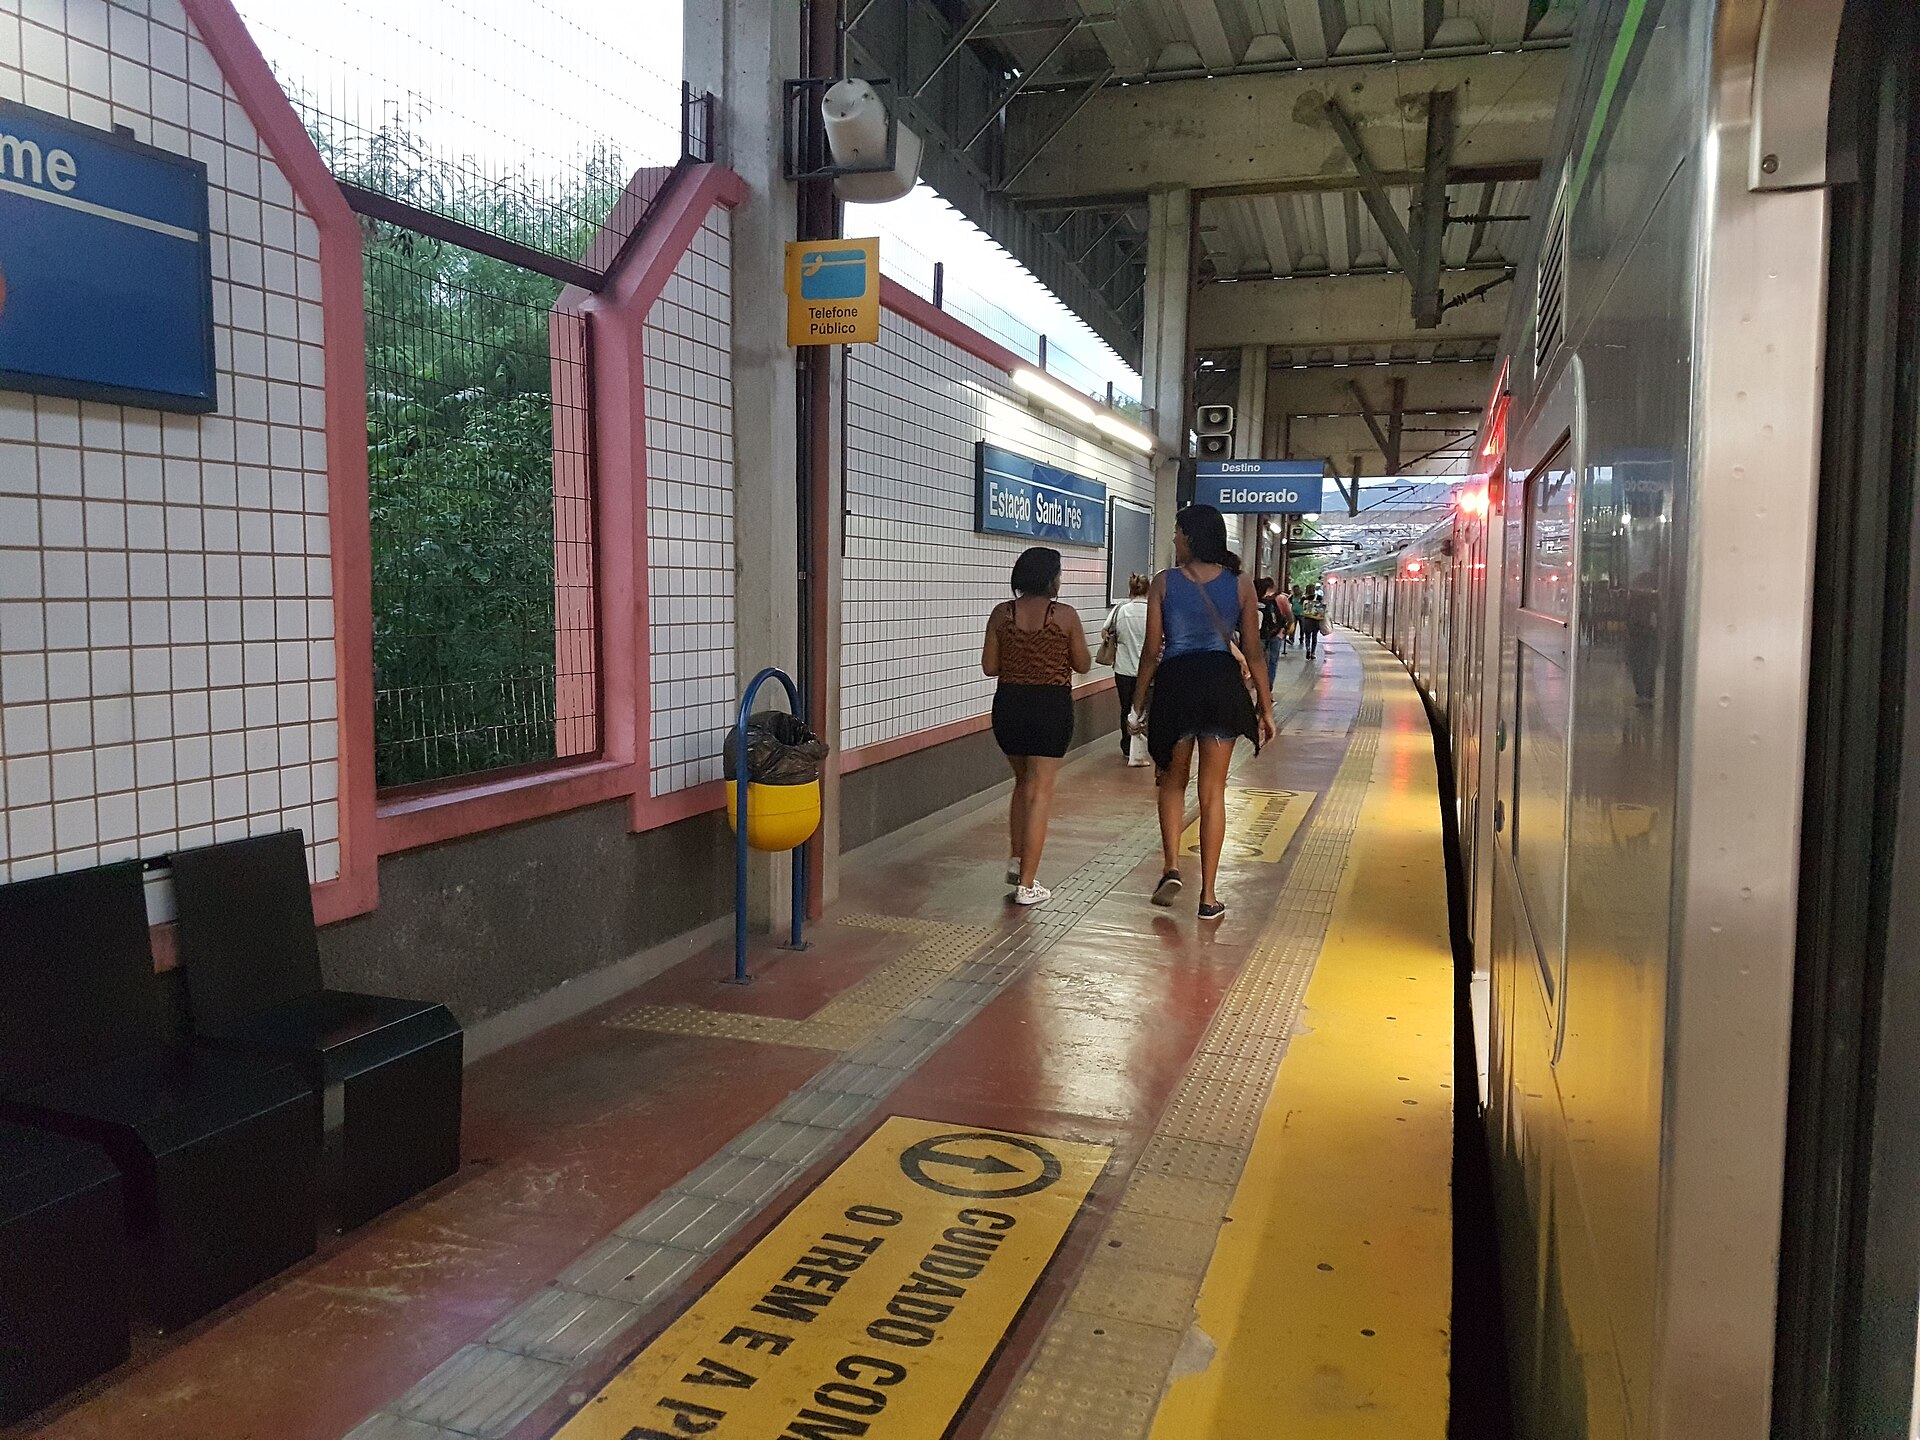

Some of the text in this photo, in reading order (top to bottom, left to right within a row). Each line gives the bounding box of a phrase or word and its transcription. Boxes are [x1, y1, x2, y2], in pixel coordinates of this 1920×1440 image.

[808, 306, 858, 319] Telefone
[810, 322, 856, 335] Público
[1221, 463, 1261, 472] Destino
[989, 482, 1031, 529] Estação
[1035, 492, 1063, 526] Santa
[1219, 488, 1299, 504] Eldorado
[844, 1204, 903, 1227] O
[750, 1233, 885, 1323] TREM
[866, 1208, 1016, 1348] CUIDADO
[718, 1326, 795, 1356] E
[681, 1357, 758, 1390] A
